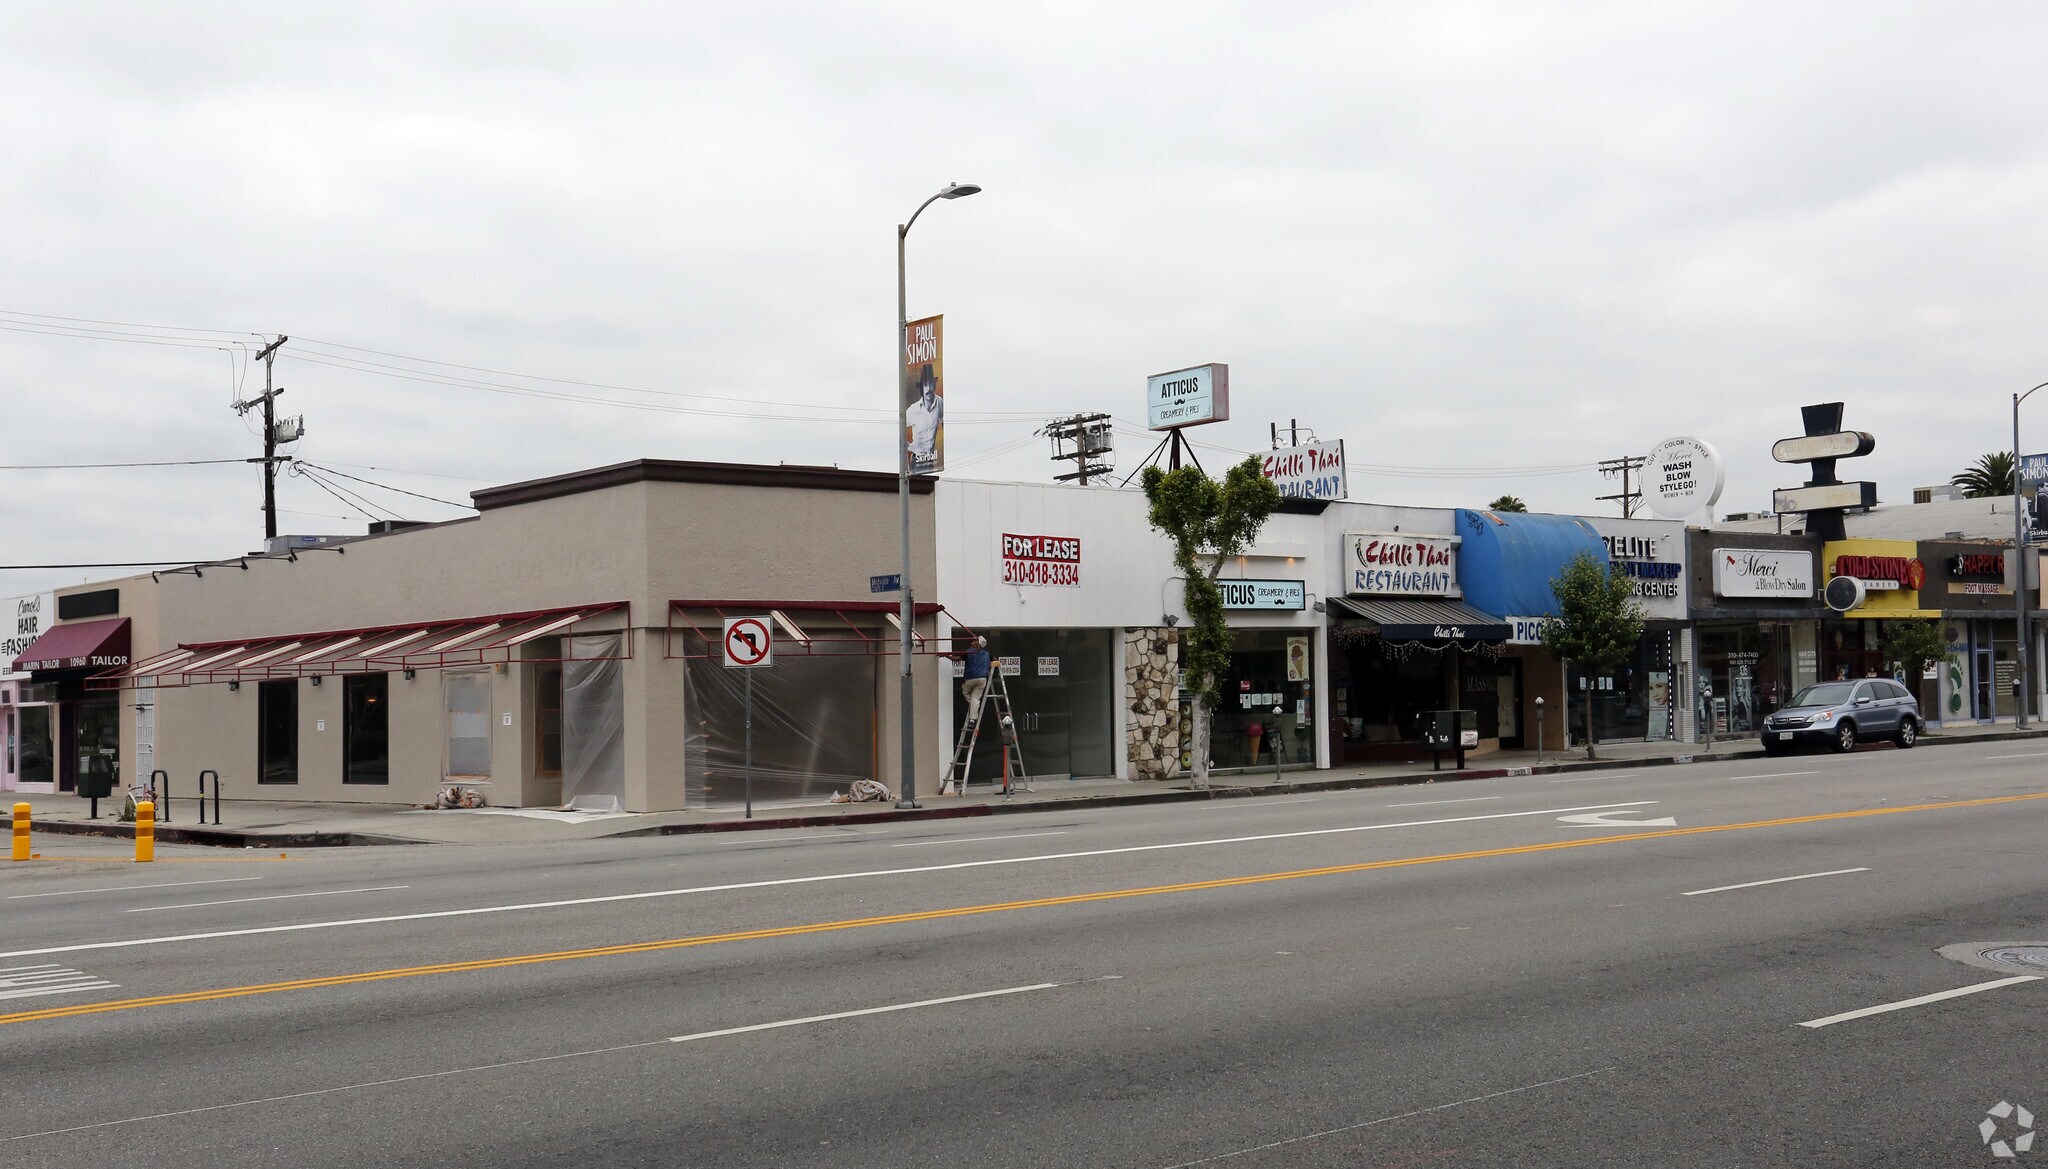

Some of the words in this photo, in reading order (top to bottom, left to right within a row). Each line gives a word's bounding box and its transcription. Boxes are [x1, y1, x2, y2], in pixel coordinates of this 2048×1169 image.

[916, 323, 936, 343] PAUL
[907, 339, 937, 365] SIMON
[1161, 377, 1199, 399] ATTICUS
[1160, 407, 1184, 420] CREAMERY
[1189, 405, 1200, 415] PIES
[1647, 454, 1657, 466] CUT
[1664, 439, 1685, 449] COLOR
[1693, 443, 1709, 460] STYLE
[1660, 450, 1692, 463] Merci
[1263, 454, 1304, 480] Chilli
[1308, 447, 1340, 474] Thai
[1663, 460, 1692, 472] WASH
[1666, 471, 1691, 482] BLOW
[1276, 475, 1340, 499] TAURANT
[1003, 536, 1033, 557] FOR
[1035, 538, 1078, 559] LEASE
[1365, 540, 1412, 567] Chilli
[1416, 543, 1450, 567] Thai
[1004, 560, 1079, 585] 310-818-3334
[1640, 562, 1682, 579] MAKEUP
[1736, 553, 1779, 577] Merci
[1871, 556, 1909, 584] STONE
[1963, 554, 1994, 574] HAPPY
[1355, 569, 1450, 593] RESTAURANT
[1644, 582, 1679, 597] CENTER
[1787, 577, 1807, 591] Salon
[1218, 584, 1256, 605] TICUS
[1258, 587, 1284, 597] CREAMERY
[1290, 588, 1300, 597] PIES
[18, 616, 38, 635] HAIR
[23, 661, 40, 670] MARIN
[42, 660, 60, 669] TAILOR
[70, 656, 86, 667] 10960
[91, 655, 128, 665] TAILOR
[1008, 658, 1020, 666] LEASE
[1047, 658, 1058, 666] LEASE
